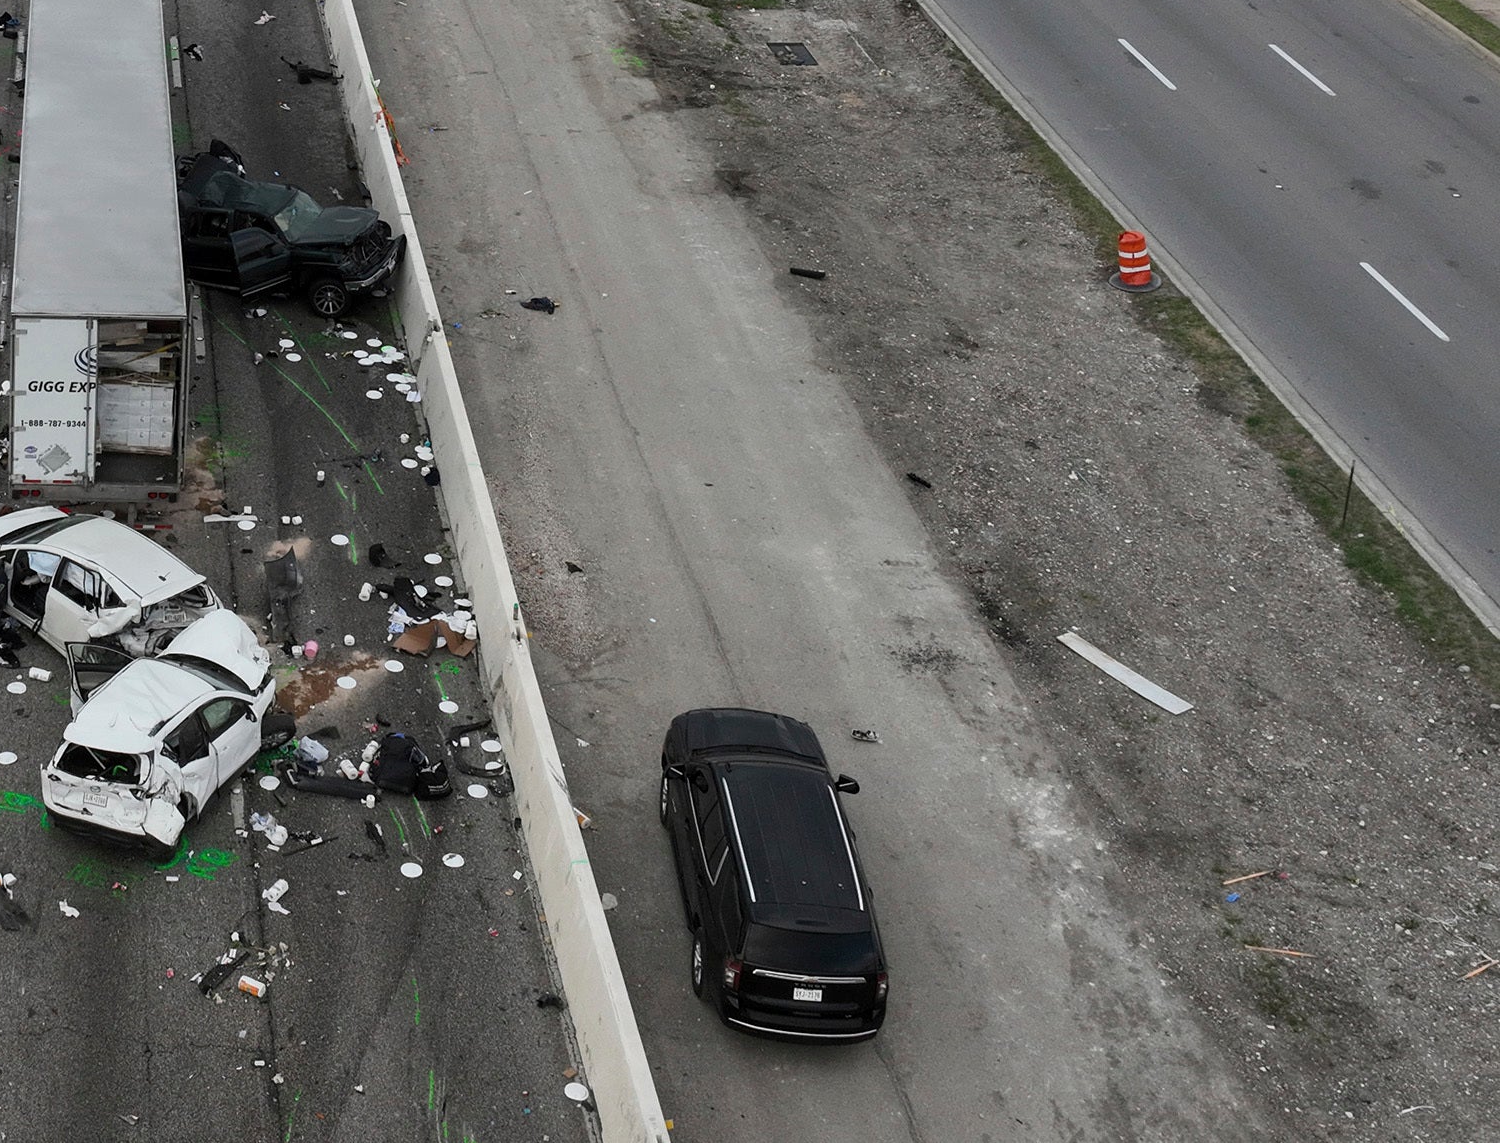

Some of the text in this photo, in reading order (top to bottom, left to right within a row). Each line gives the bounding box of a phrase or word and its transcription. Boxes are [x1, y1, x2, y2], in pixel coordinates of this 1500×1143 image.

[28, 381, 97, 393] GIGG EXP
[21, 419, 86, 427] 1-888-787-9344
